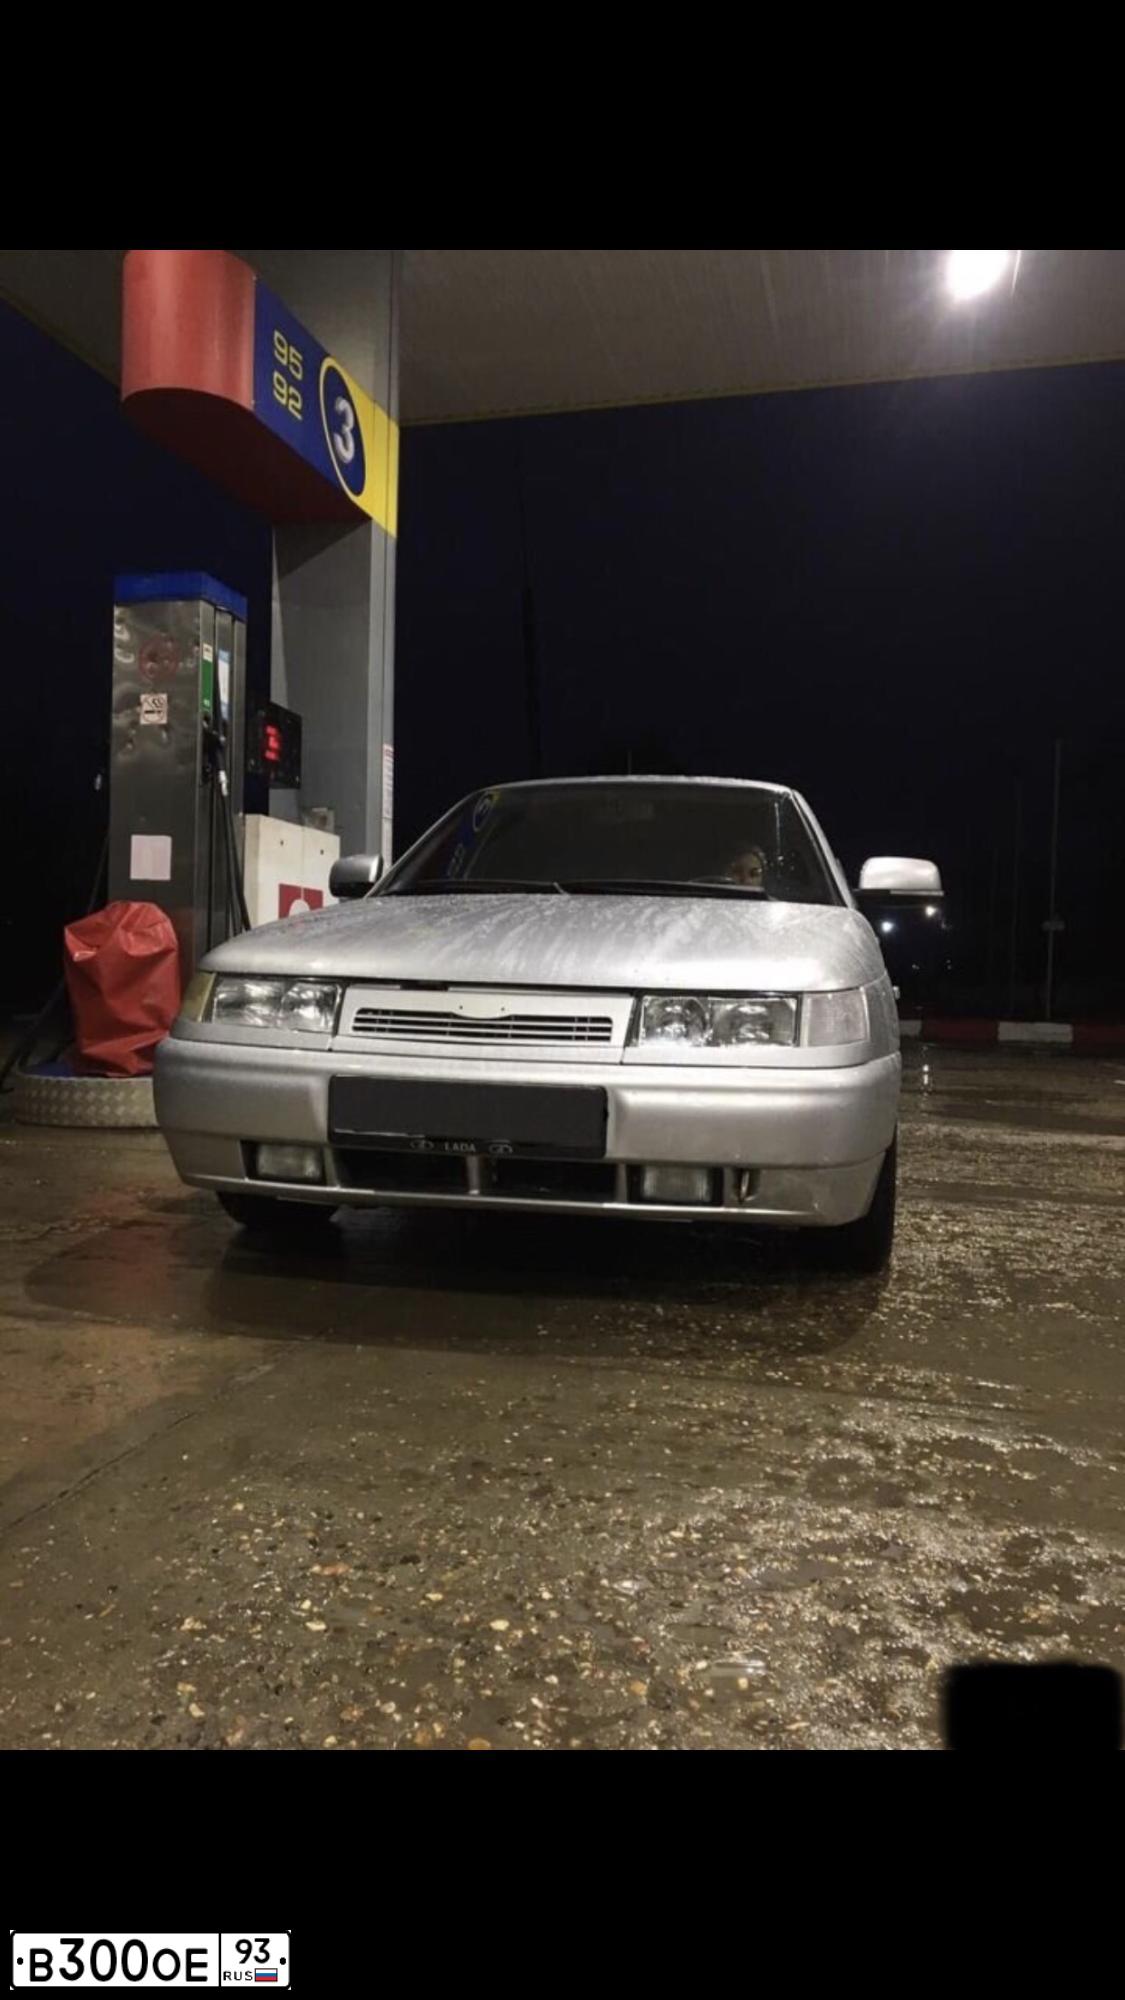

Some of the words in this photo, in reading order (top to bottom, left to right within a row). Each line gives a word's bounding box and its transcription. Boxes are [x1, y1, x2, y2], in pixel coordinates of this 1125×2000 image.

[273, 329, 303, 381] 95
[272, 370, 303, 421] 92
[333, 396, 355, 464] 3
